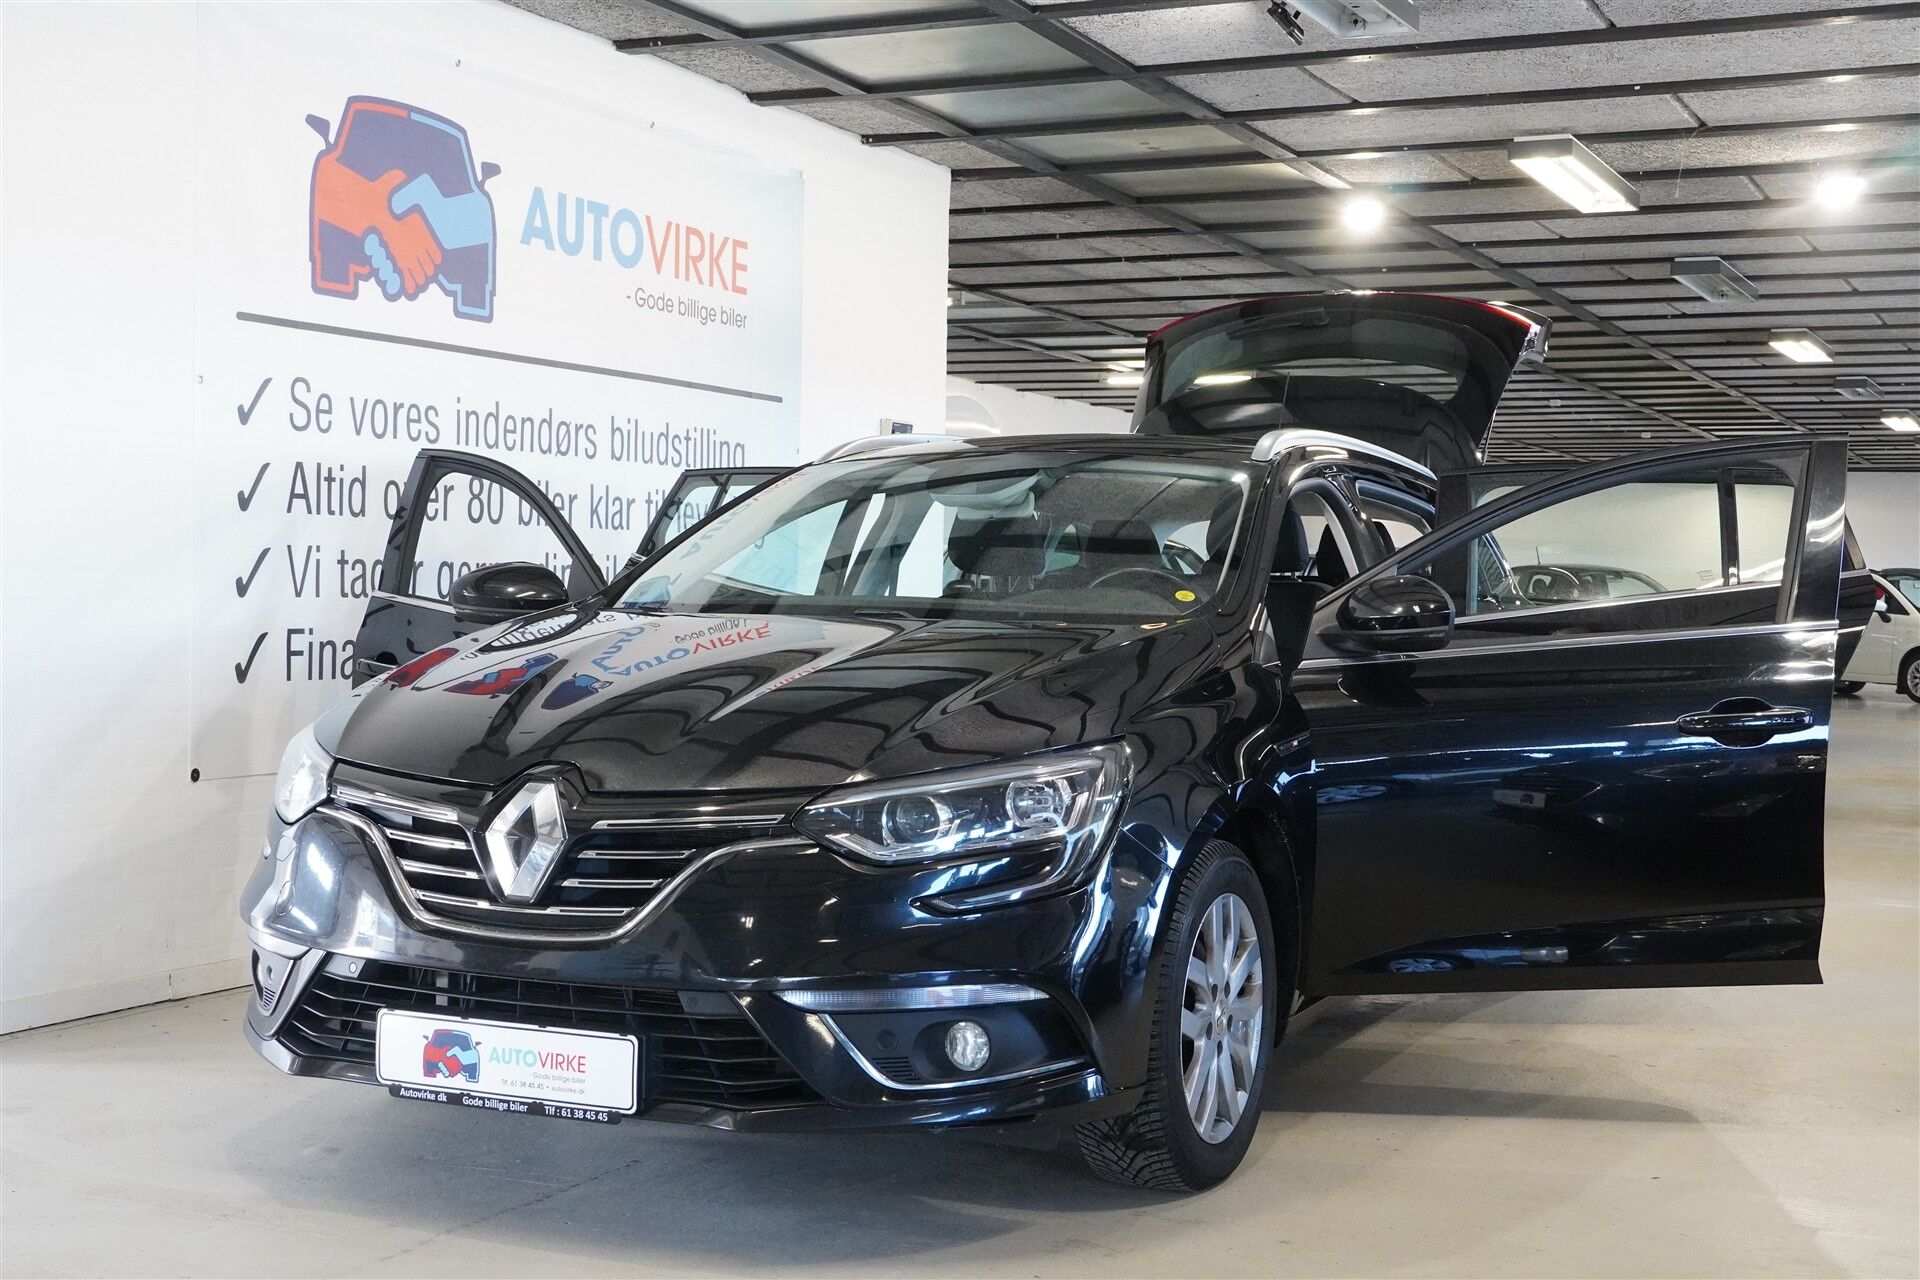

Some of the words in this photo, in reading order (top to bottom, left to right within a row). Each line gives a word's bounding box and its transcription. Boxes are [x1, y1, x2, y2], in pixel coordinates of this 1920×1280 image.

[520, 186, 748, 295] AUTOVIRKE
[634, 287, 675, 314] Gode
[678, 296, 717, 326] billige
[720, 308, 748, 329] biler
[289, 376, 333, 435] Se
[349, 396, 440, 444] vores
[456, 396, 598, 460] indendørs
[286, 461, 367, 518] Altid
[383, 479, 455, 522] oer
[467, 475, 504, 525] 80
[590, 484, 635, 530] klar
[645, 488, 667, 528] ti
[286, 544, 321, 598] Vi
[488, 1046, 587, 1073] AUTOVIRKE
[400, 1088, 436, 1101] Autovirke
[437, 1093, 448, 1102] dk
[462, 1096, 484, 1107] Gode
[485, 1098, 509, 1111] billige
[510, 1102, 529, 1113] biler
[544, 1106, 556, 1116] Tlf
[561, 1108, 572, 1118] 61
[573, 1110, 584, 1119] 38
[585, 1111, 596, 1121] 45
[597, 1112, 608, 1122] 45
